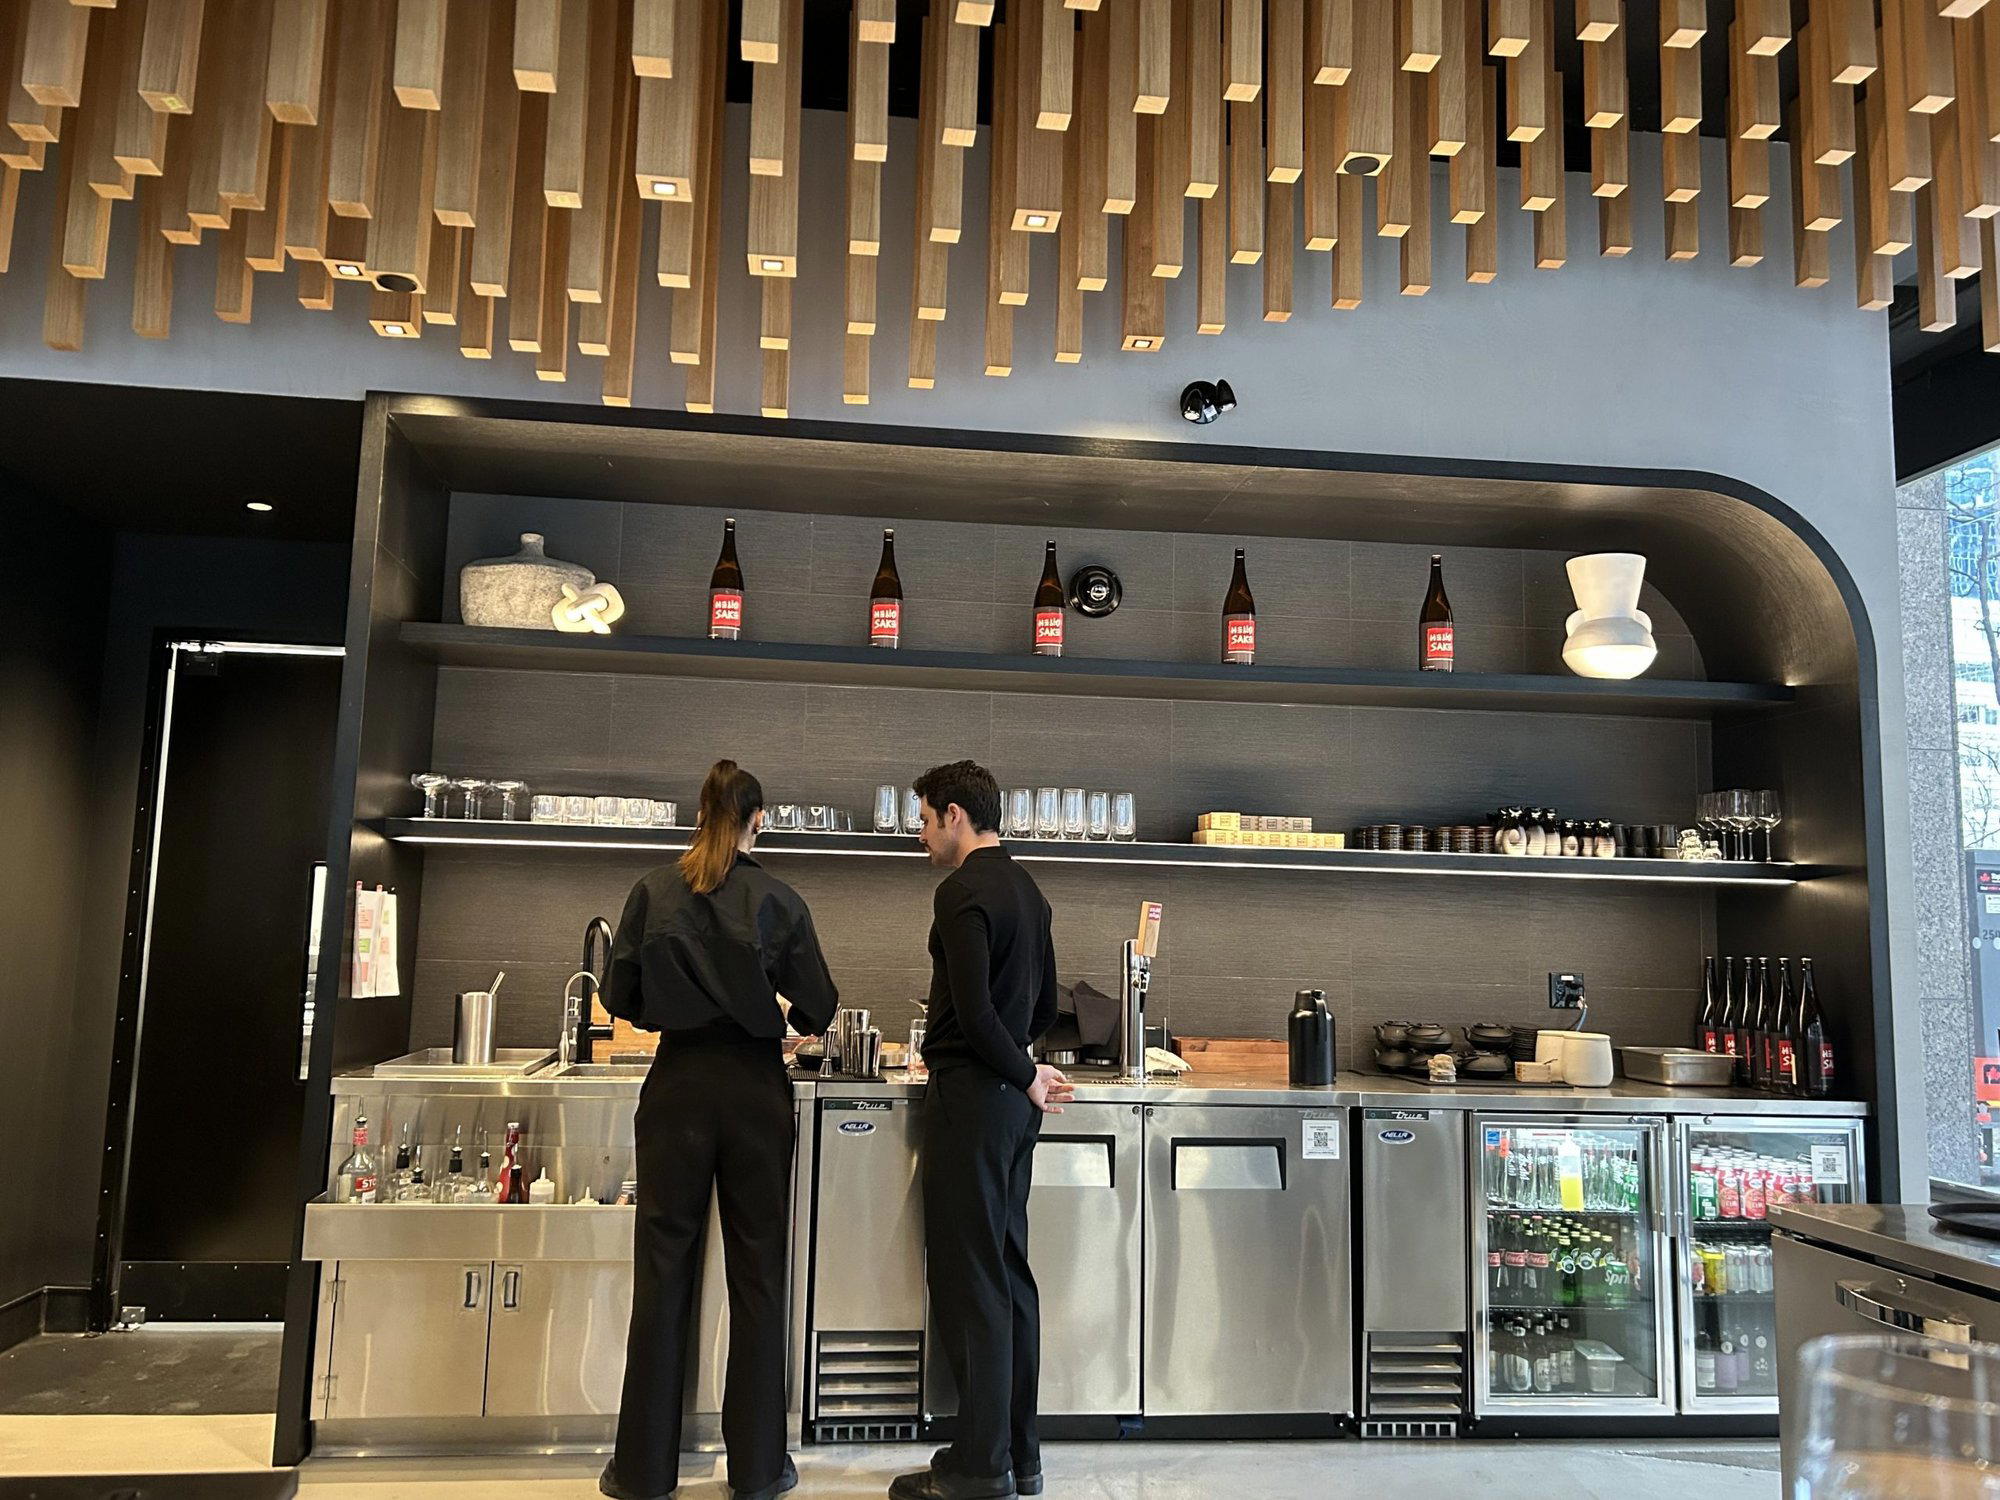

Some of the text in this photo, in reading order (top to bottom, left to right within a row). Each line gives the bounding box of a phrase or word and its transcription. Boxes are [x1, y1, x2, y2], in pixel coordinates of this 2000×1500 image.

[715, 609, 739, 620] SAKE
[874, 619, 897, 629] SAKE
[1038, 627, 1061, 637] SAKE
[1231, 635, 1253, 645] SAKE
[1430, 642, 1452, 652] SAKE
